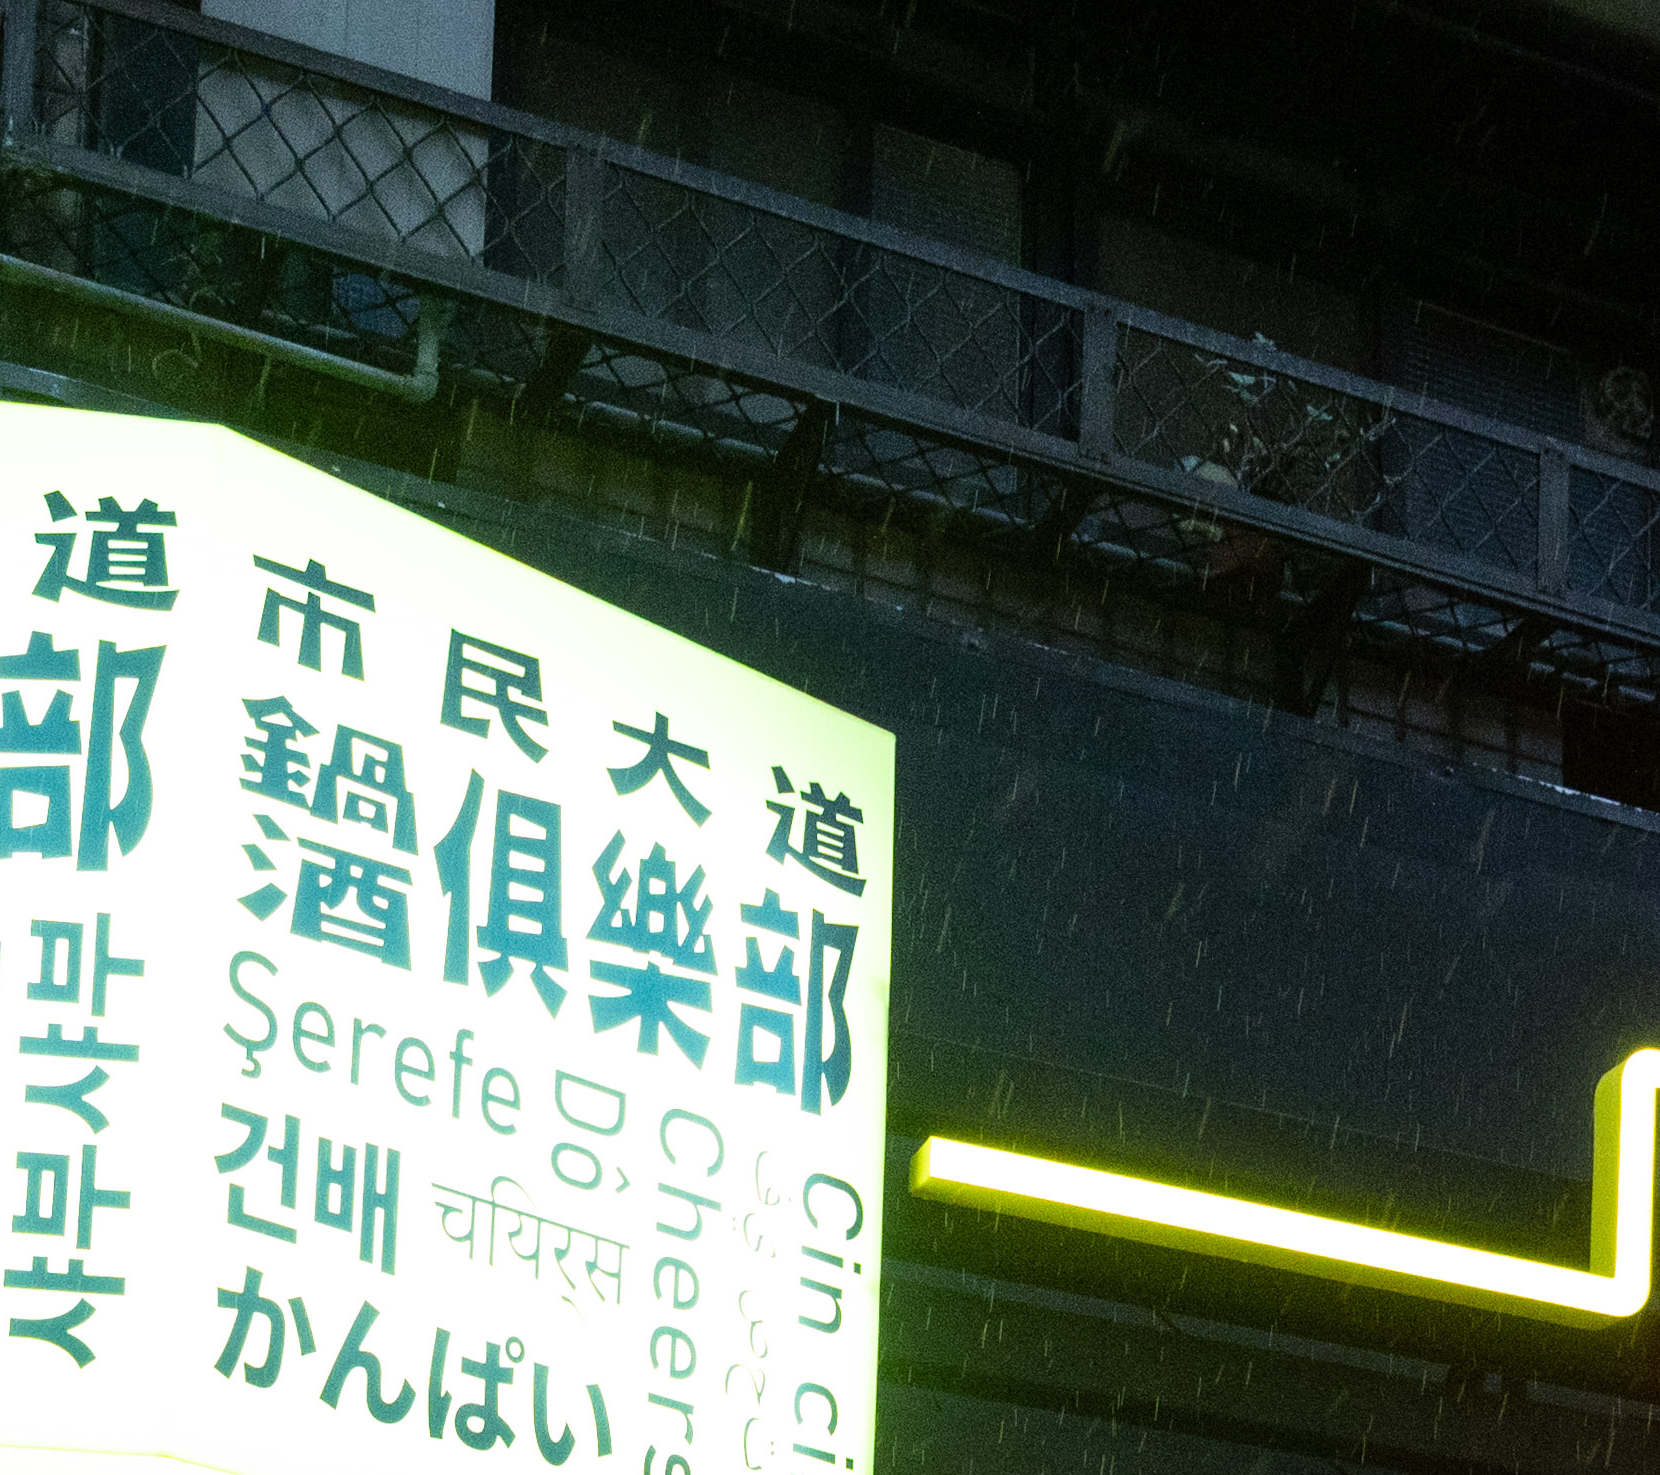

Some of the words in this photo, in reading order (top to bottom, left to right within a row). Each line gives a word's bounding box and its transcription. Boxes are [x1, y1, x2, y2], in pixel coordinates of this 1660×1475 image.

[249, 556, 868, 898] 市民大道
[222, 951, 521, 1135] Şerefe
[214, 1102, 401, 1276] 건배
[798, 1172, 863, 1335] Cin
[213, 1265, 613, 1466] かんぱい
